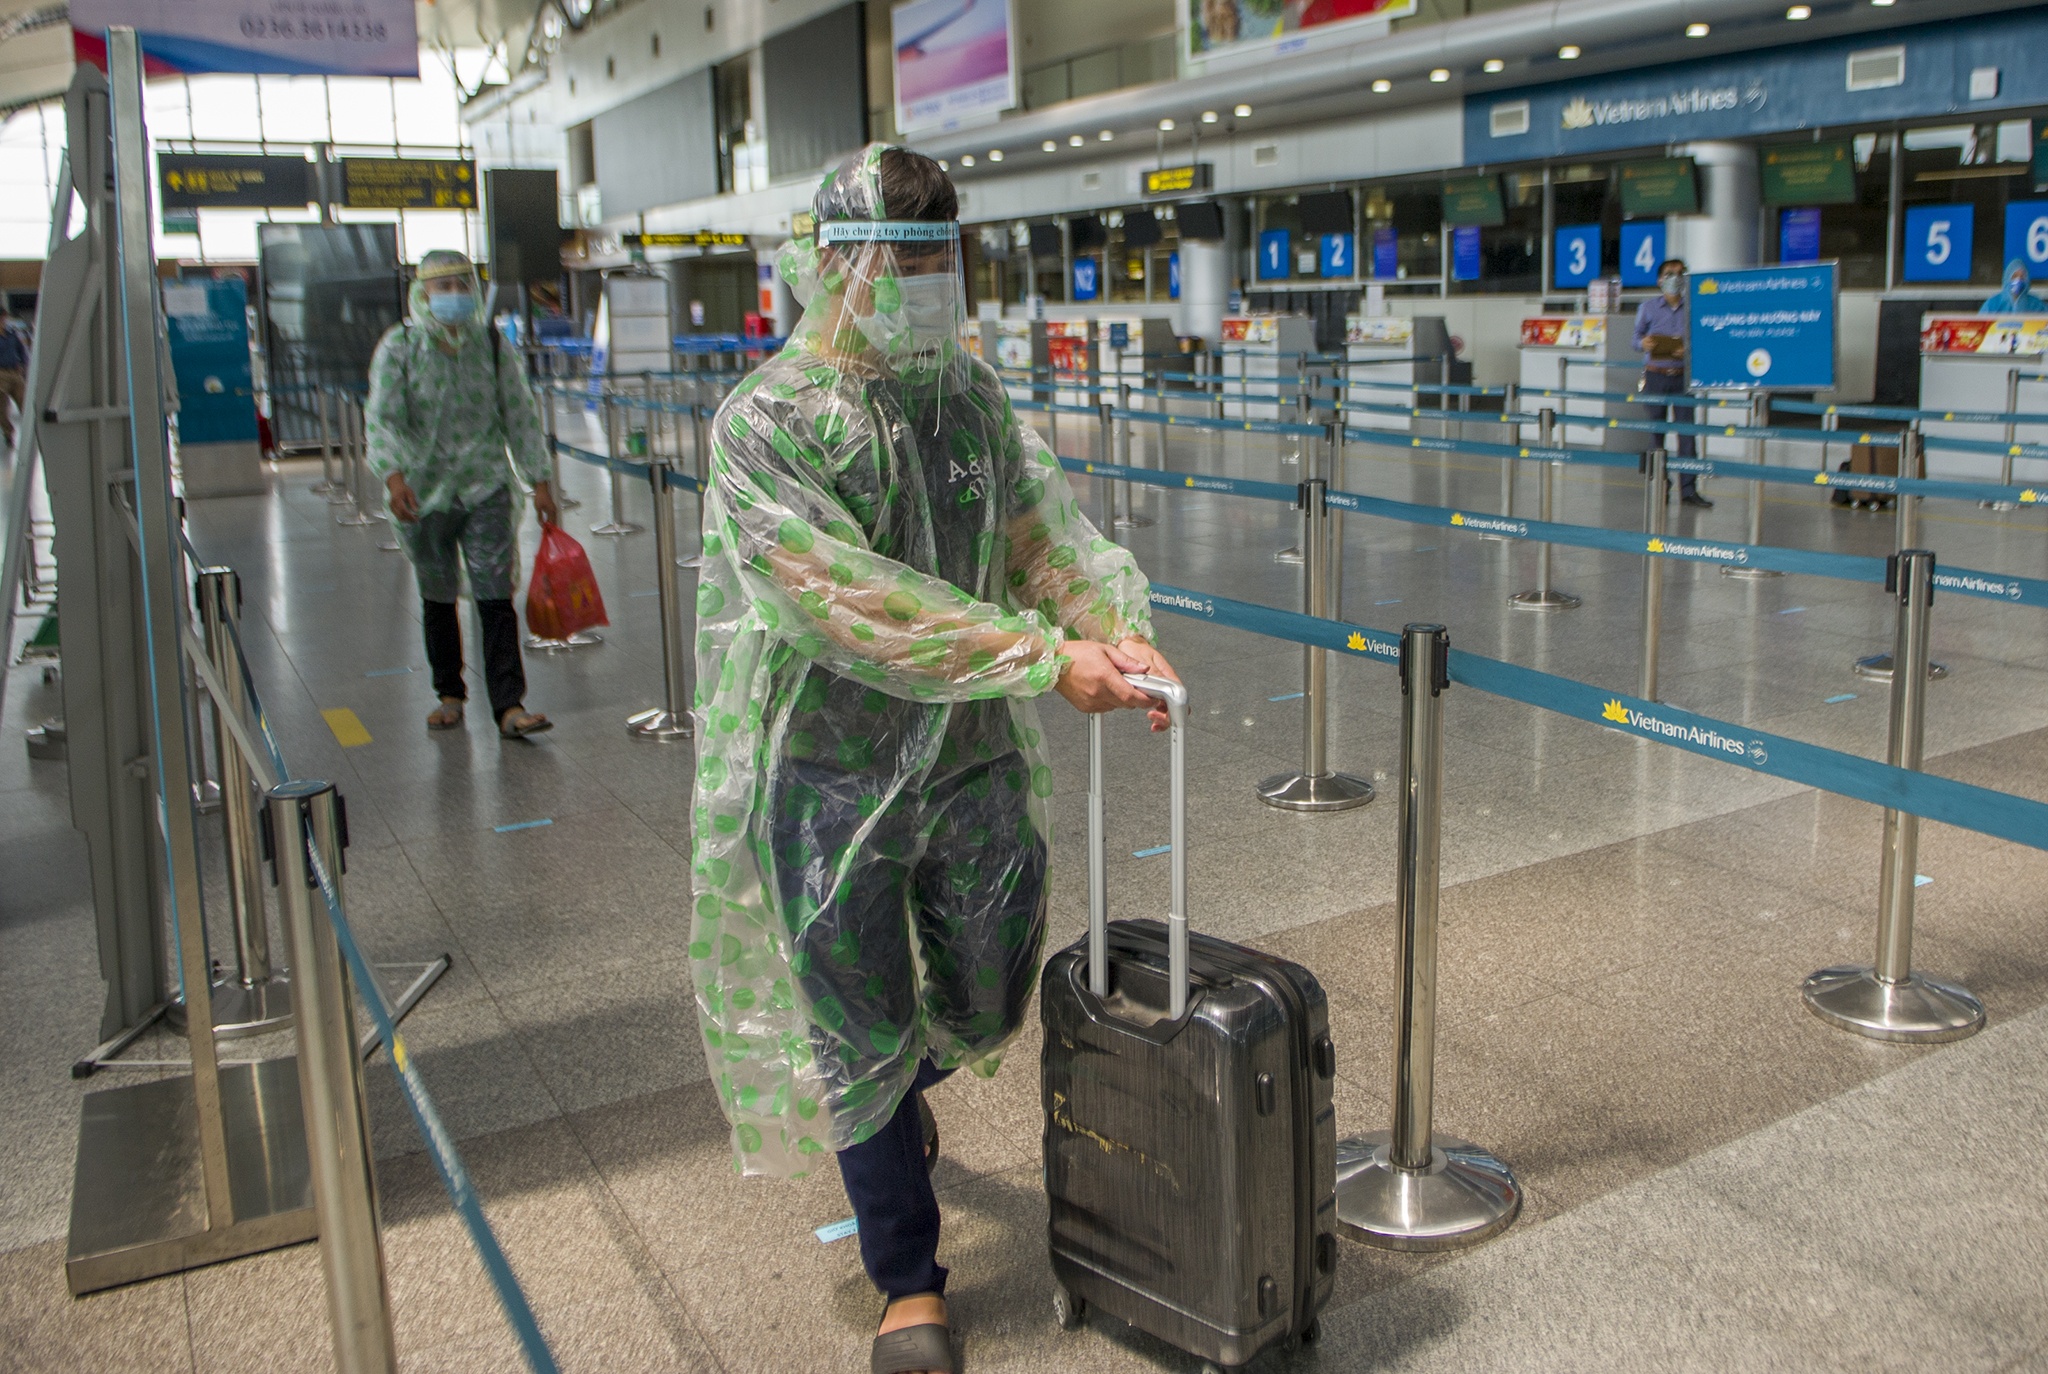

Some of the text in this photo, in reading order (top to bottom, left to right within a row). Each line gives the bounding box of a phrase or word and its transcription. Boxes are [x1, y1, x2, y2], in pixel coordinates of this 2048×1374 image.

[1593, 86, 1738, 126] Vietnam Airlines
[884, 227, 900, 239] tay
[903, 226, 934, 239] phòng
[1926, 220, 1951, 265] 5
[2027, 216, 2048, 263] 6
[1269, 240, 1279, 270] 1
[1331, 235, 1345, 267] 2
[1569, 237, 1587, 275] 3
[1634, 235, 1655, 273] 4
[1463, 517, 1517, 533] Vietnam Airlines
[1664, 542, 1734, 560] Vietnam Airlines
[1960, 576, 2005, 595] Airlines
[1175, 594, 1203, 612] Airlines
[1366, 638, 1400, 658] Vietna
[1629, 709, 1688, 740] Vietnam
[1688, 726, 1745, 755] Airlines
